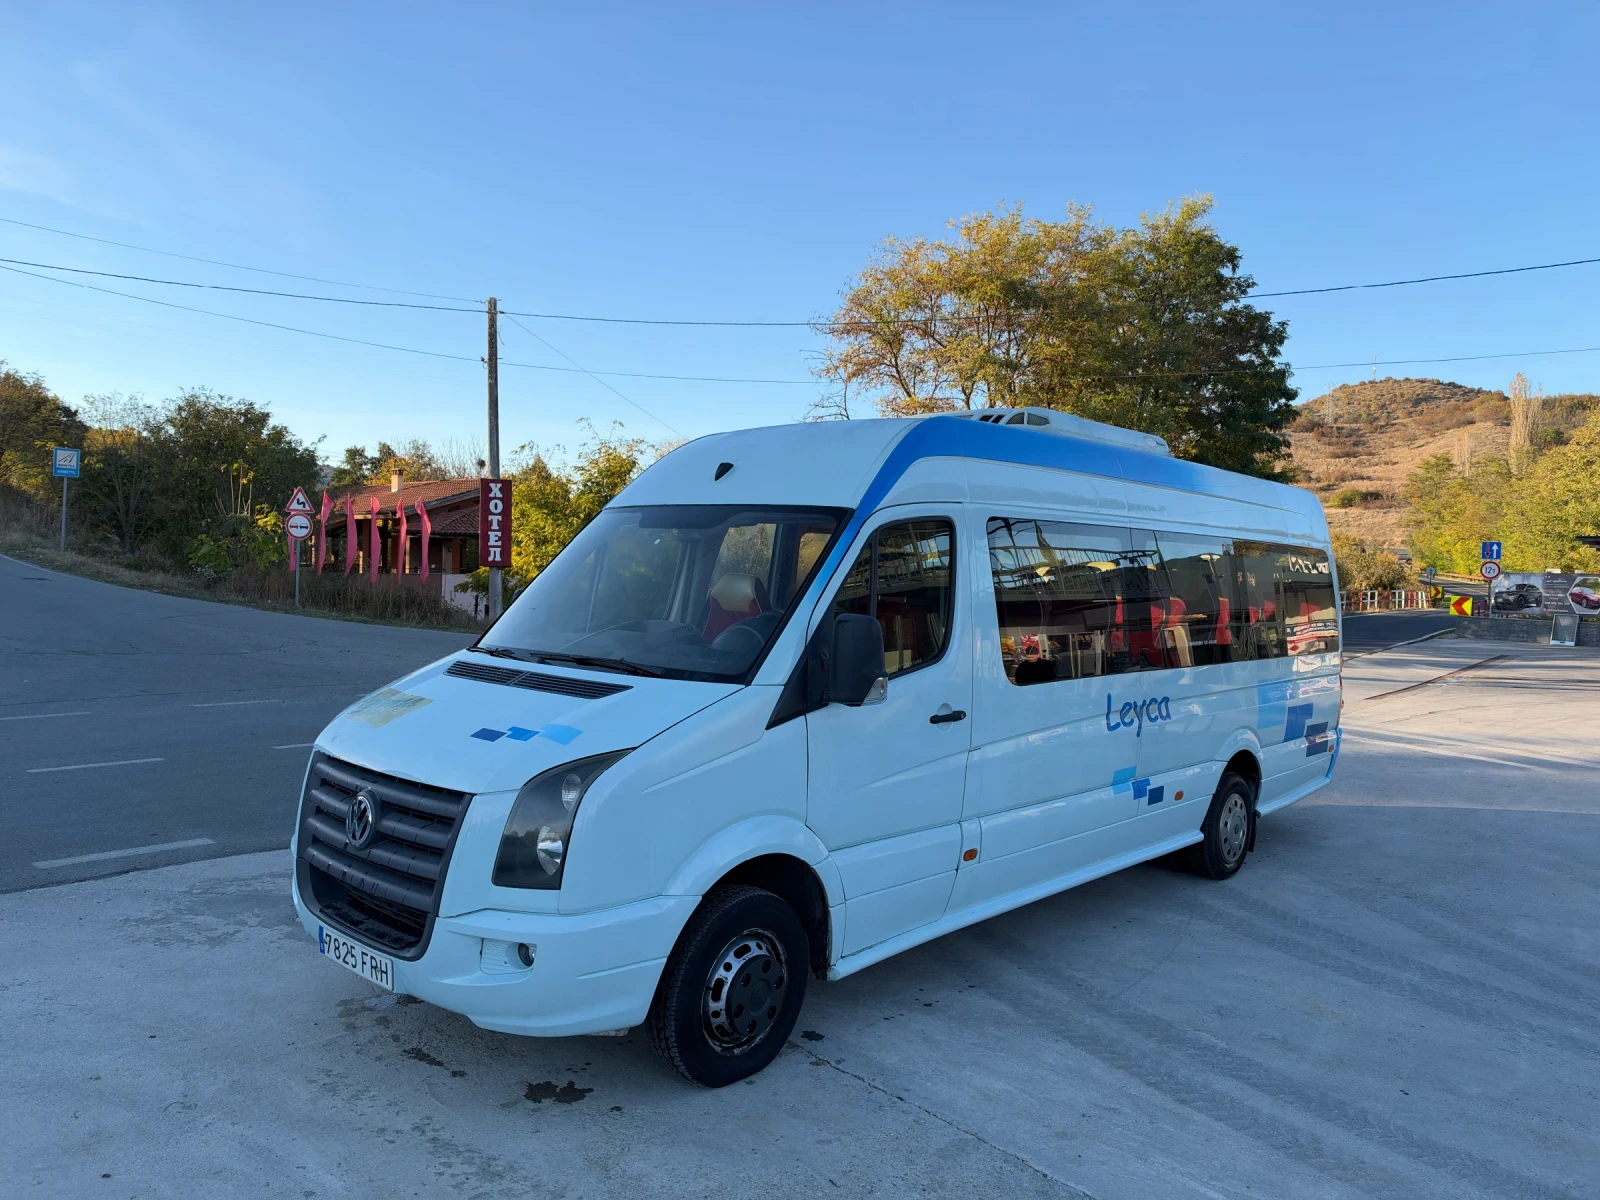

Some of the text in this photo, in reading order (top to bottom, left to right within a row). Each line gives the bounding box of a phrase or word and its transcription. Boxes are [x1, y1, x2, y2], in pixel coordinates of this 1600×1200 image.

[488, 483, 503, 561] ХОТЕЛ
[1106, 693, 1171, 737] Leyca
[324, 932, 388, 985] 7825 FRH
